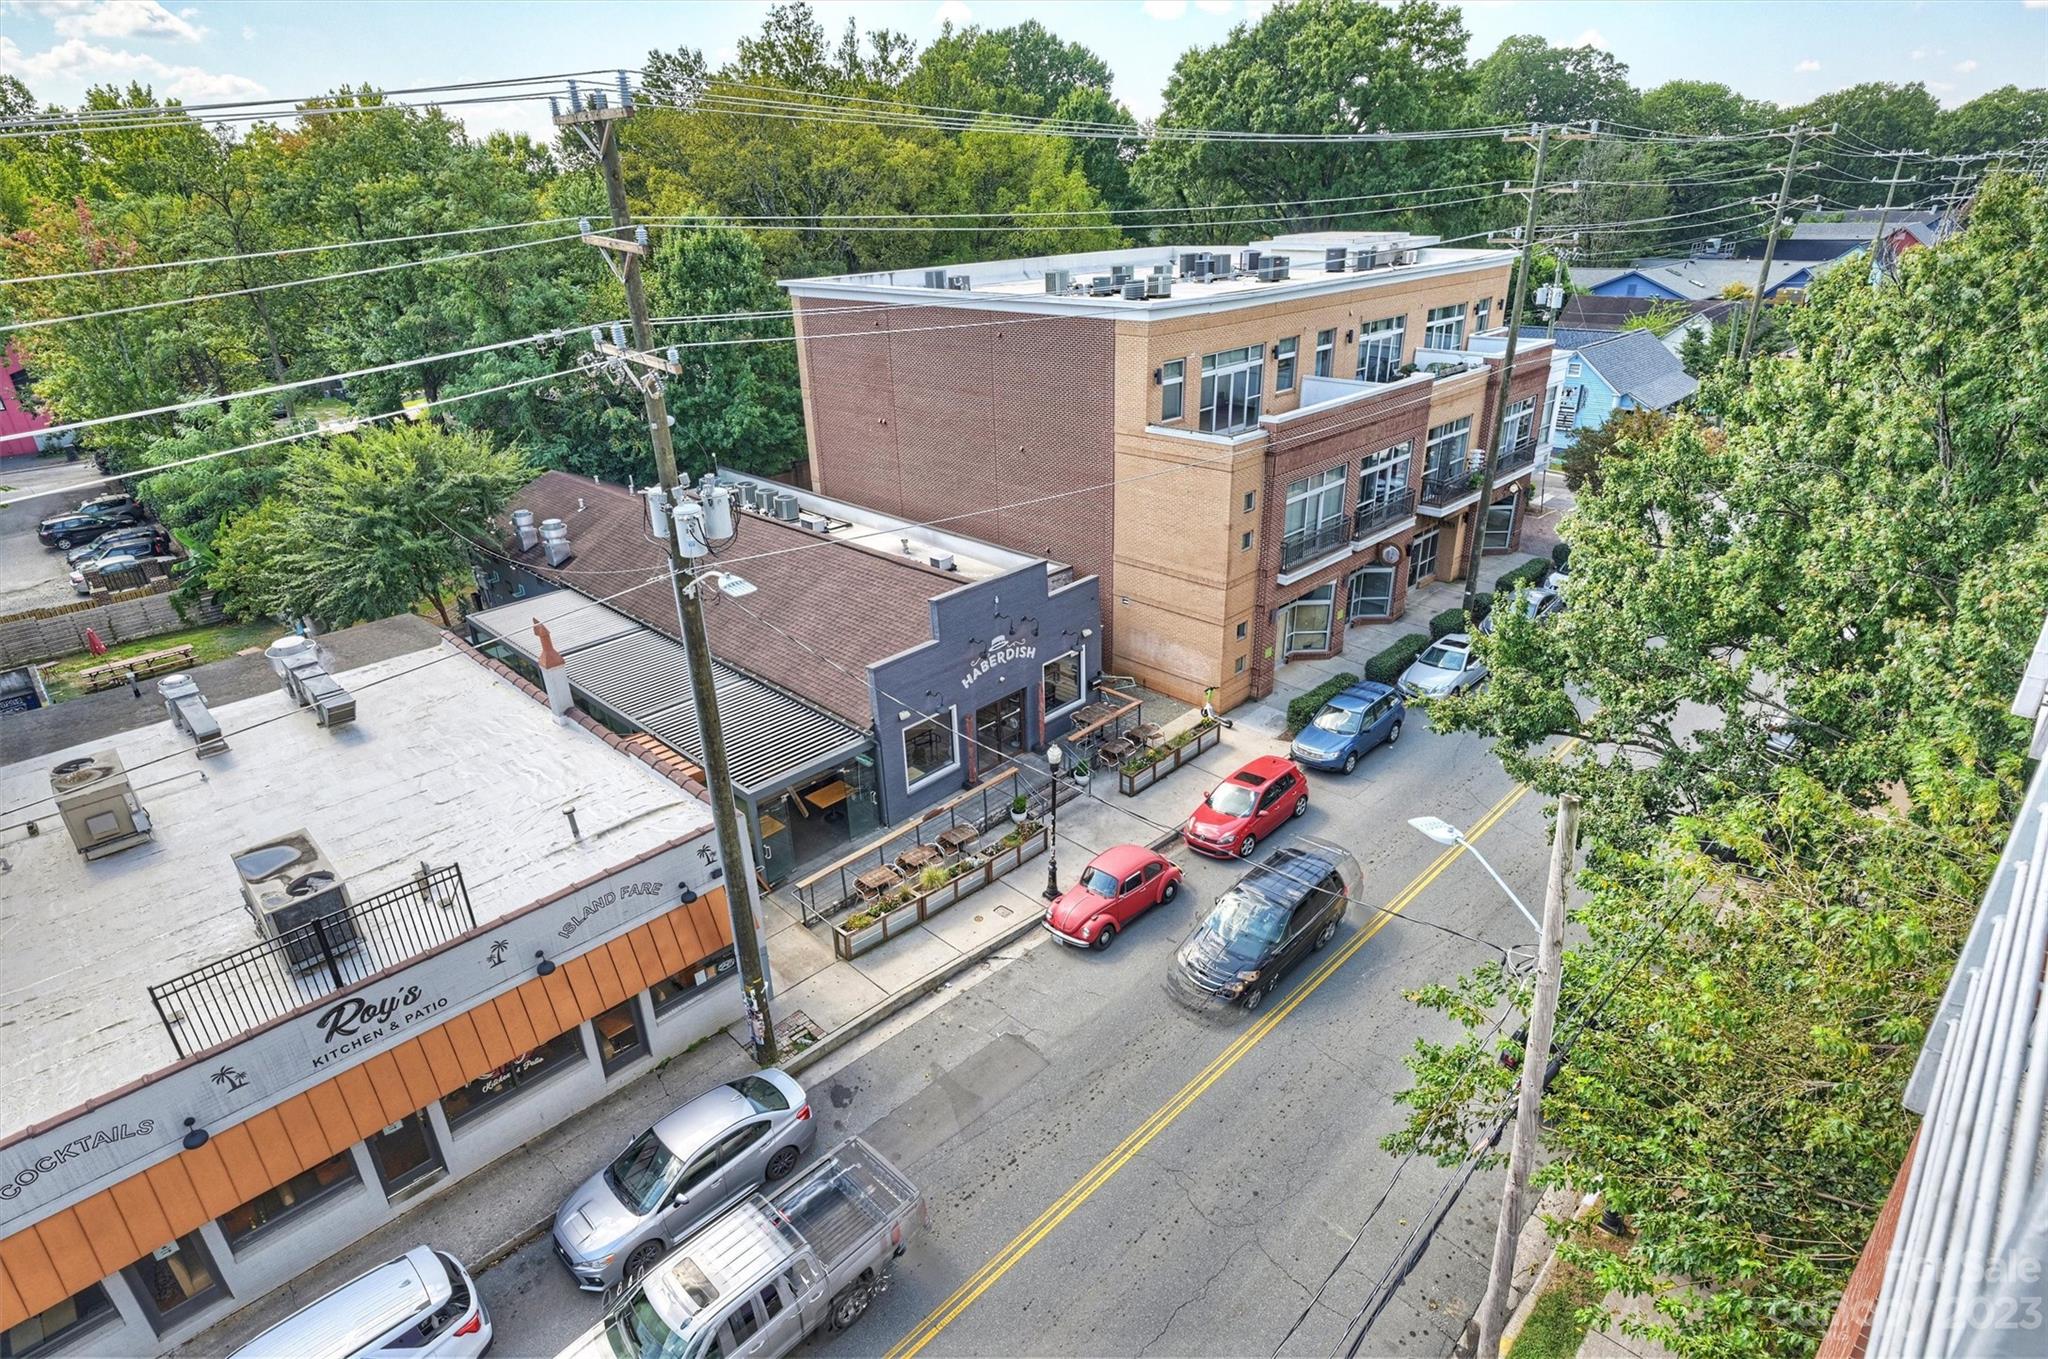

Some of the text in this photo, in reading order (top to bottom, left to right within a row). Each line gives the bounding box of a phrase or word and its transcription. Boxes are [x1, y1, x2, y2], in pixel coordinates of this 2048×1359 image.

[961, 645, 1036, 689] HABERDISH
[558, 882, 663, 939] ISLAND FARE
[312, 998, 448, 1068] KITCHEN & PATIO
[316, 985, 422, 1044] Roy's
[0, 1119, 155, 1200] COCKTAILS
